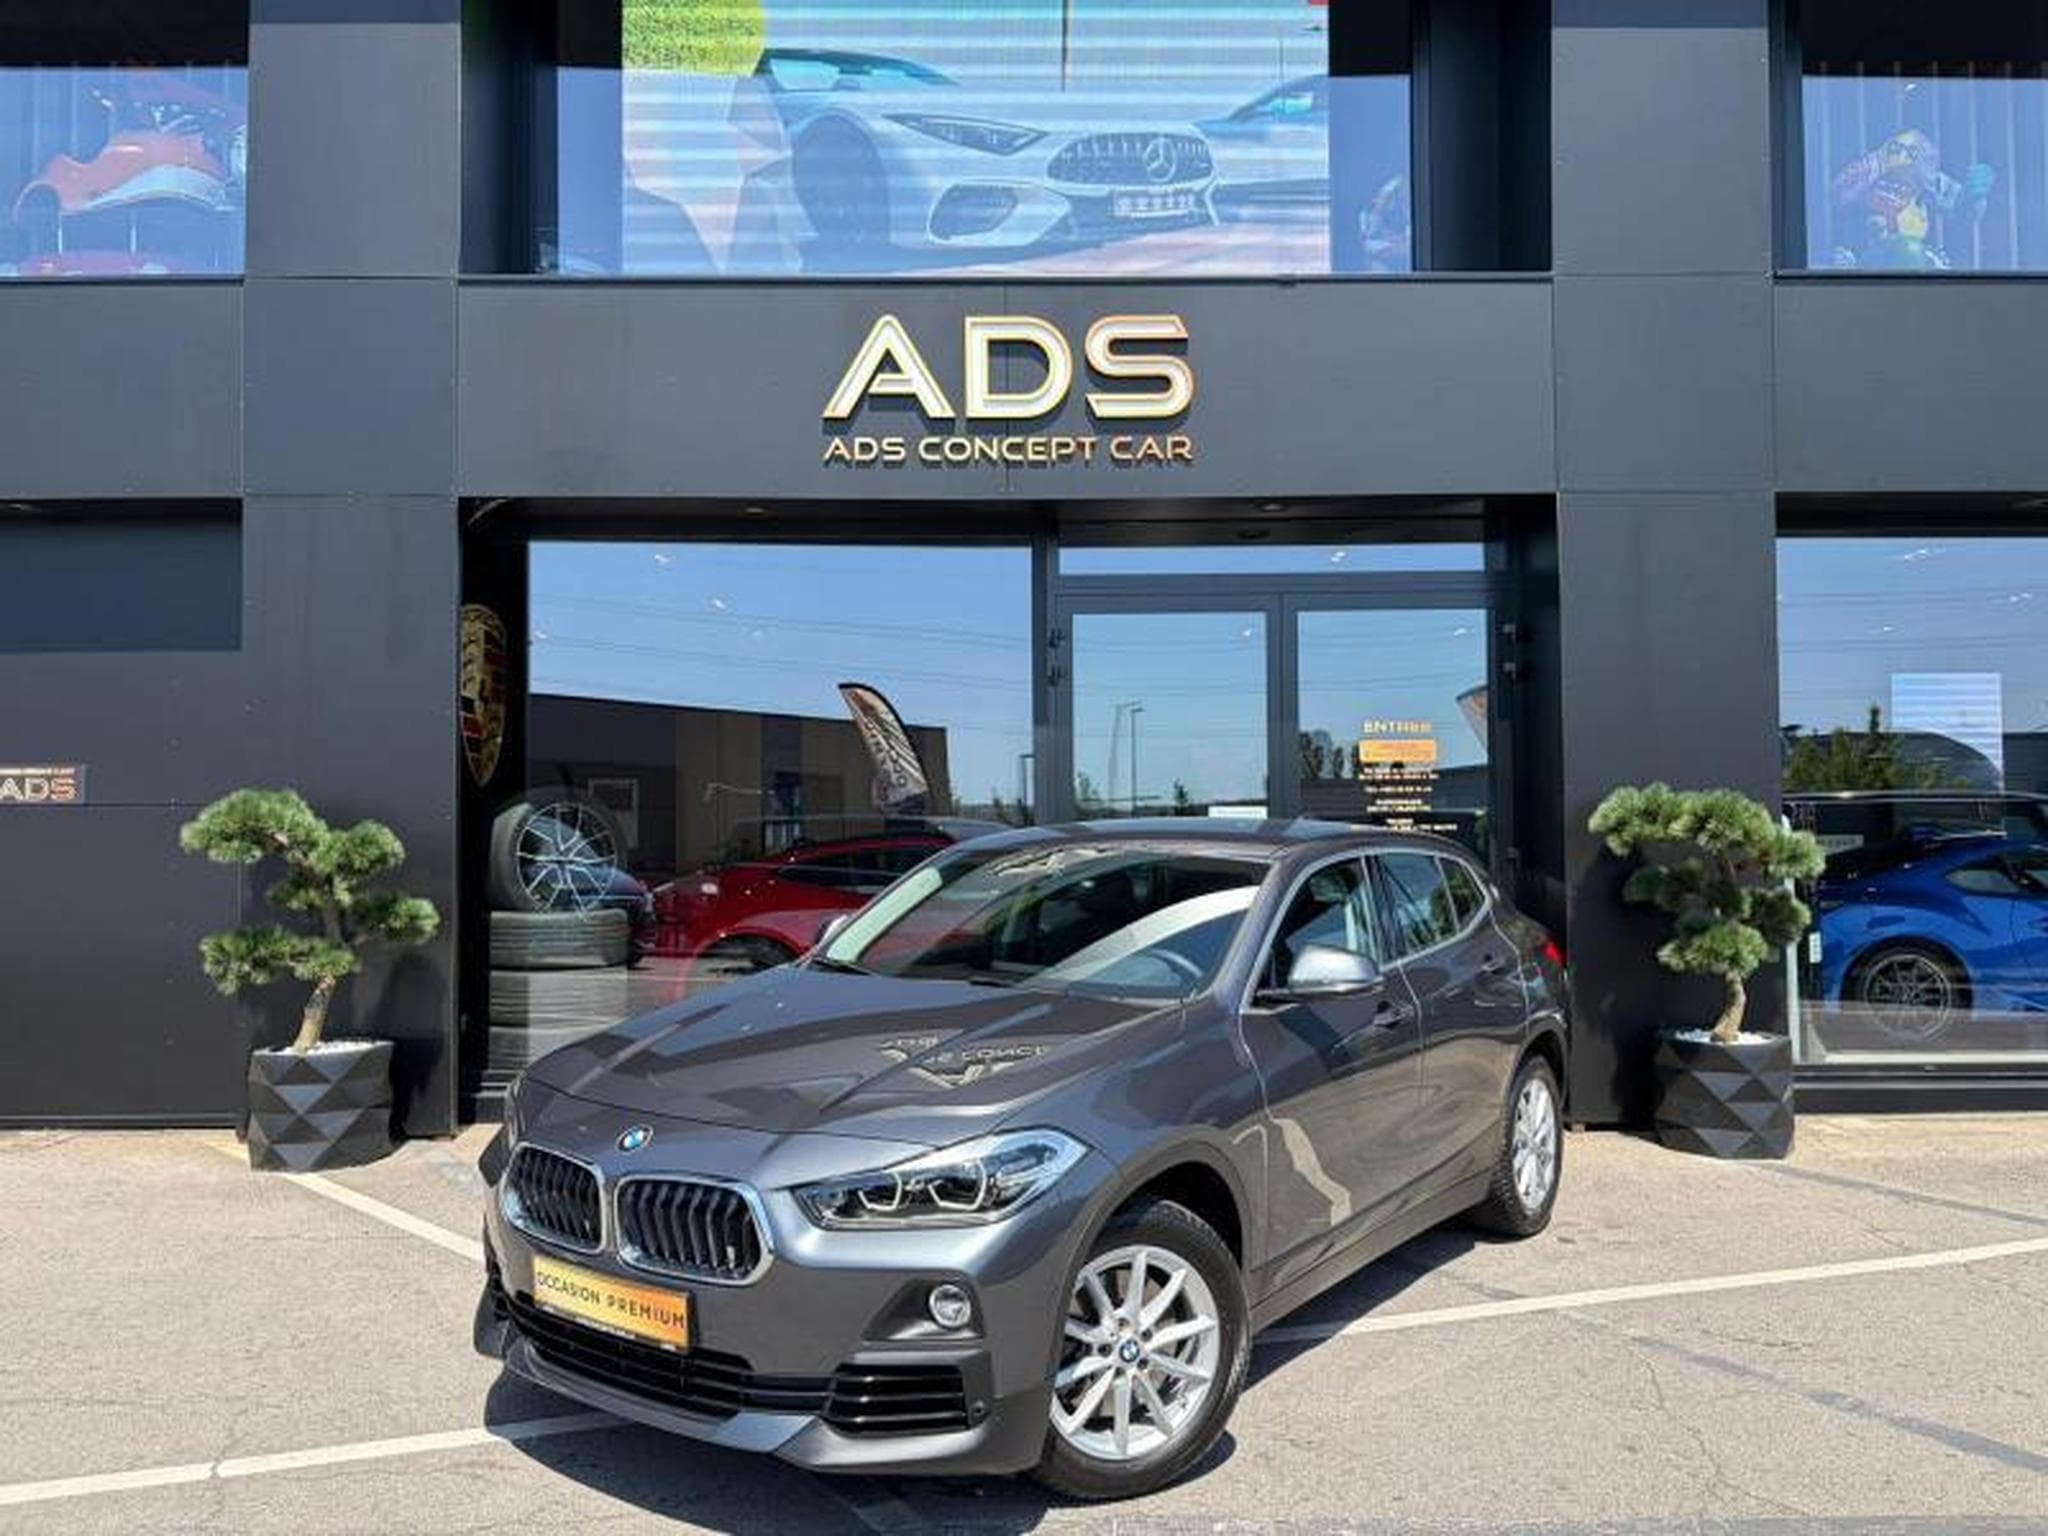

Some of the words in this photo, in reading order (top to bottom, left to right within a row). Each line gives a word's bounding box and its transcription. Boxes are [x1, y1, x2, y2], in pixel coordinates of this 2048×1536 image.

[822, 314, 1195, 418] ADS
[823, 436, 906, 463] ADS
[917, 436, 1097, 463] CONCEPT
[1109, 436, 1194, 463] CAR
[0, 777, 76, 800] ADS
[536, 1271, 601, 1304] OCCASION
[607, 1295, 685, 1329] PREMIUM
